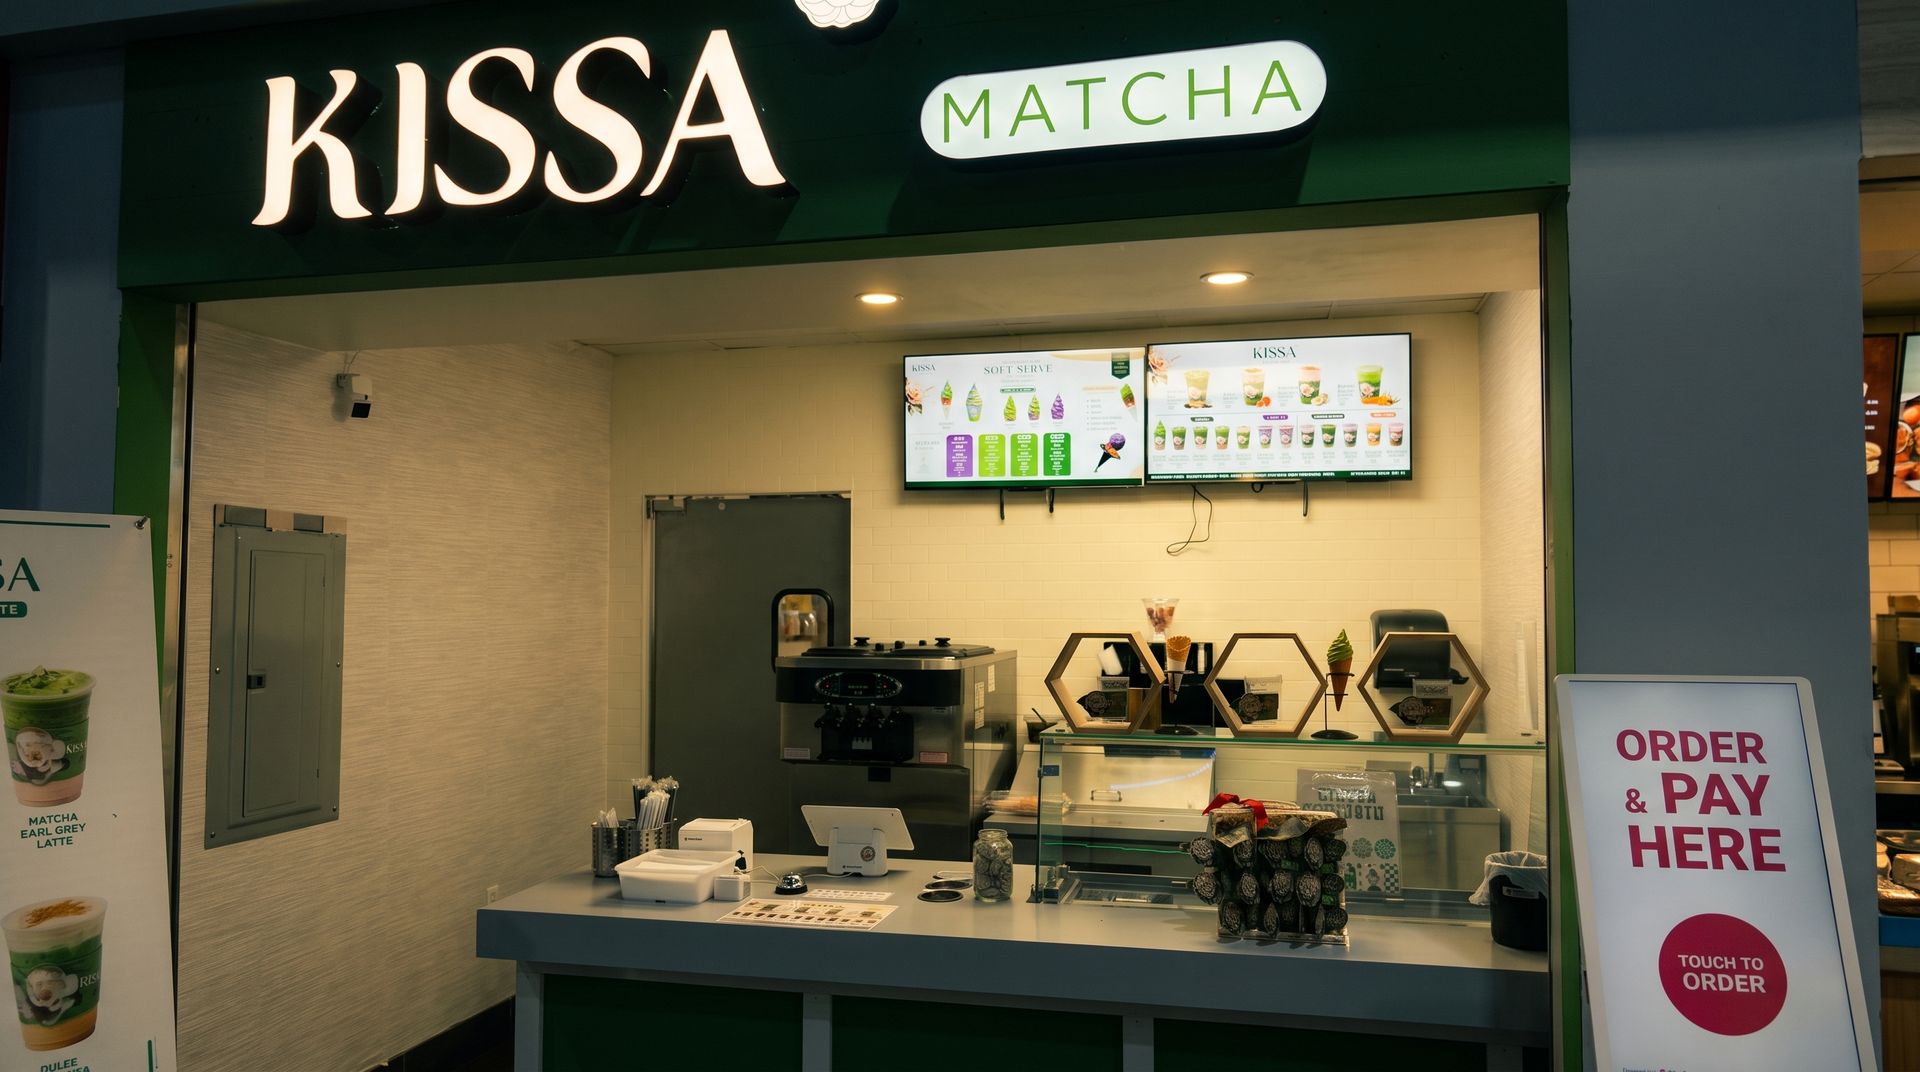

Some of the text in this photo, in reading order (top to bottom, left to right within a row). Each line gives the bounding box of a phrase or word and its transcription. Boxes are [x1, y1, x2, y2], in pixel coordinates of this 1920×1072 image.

[943, 59, 1303, 144] MATCHA
[251, 28, 787, 226] KISSA
[1252, 346, 1296, 359] KISSA
[912, 364, 937, 373] KISSA
[983, 364, 1053, 375] SOFT SERVE
[1616, 729, 1768, 764] ORDER
[1625, 772, 1771, 817] & PAY
[28, 813, 78, 826] MATCHA
[20, 823, 87, 839] EARL GREY
[37, 836, 73, 849] LATTE
[1627, 825, 1787, 873] HERE
[1677, 954, 1765, 971] TOUCH TO
[1682, 972, 1767, 993] ORDER
